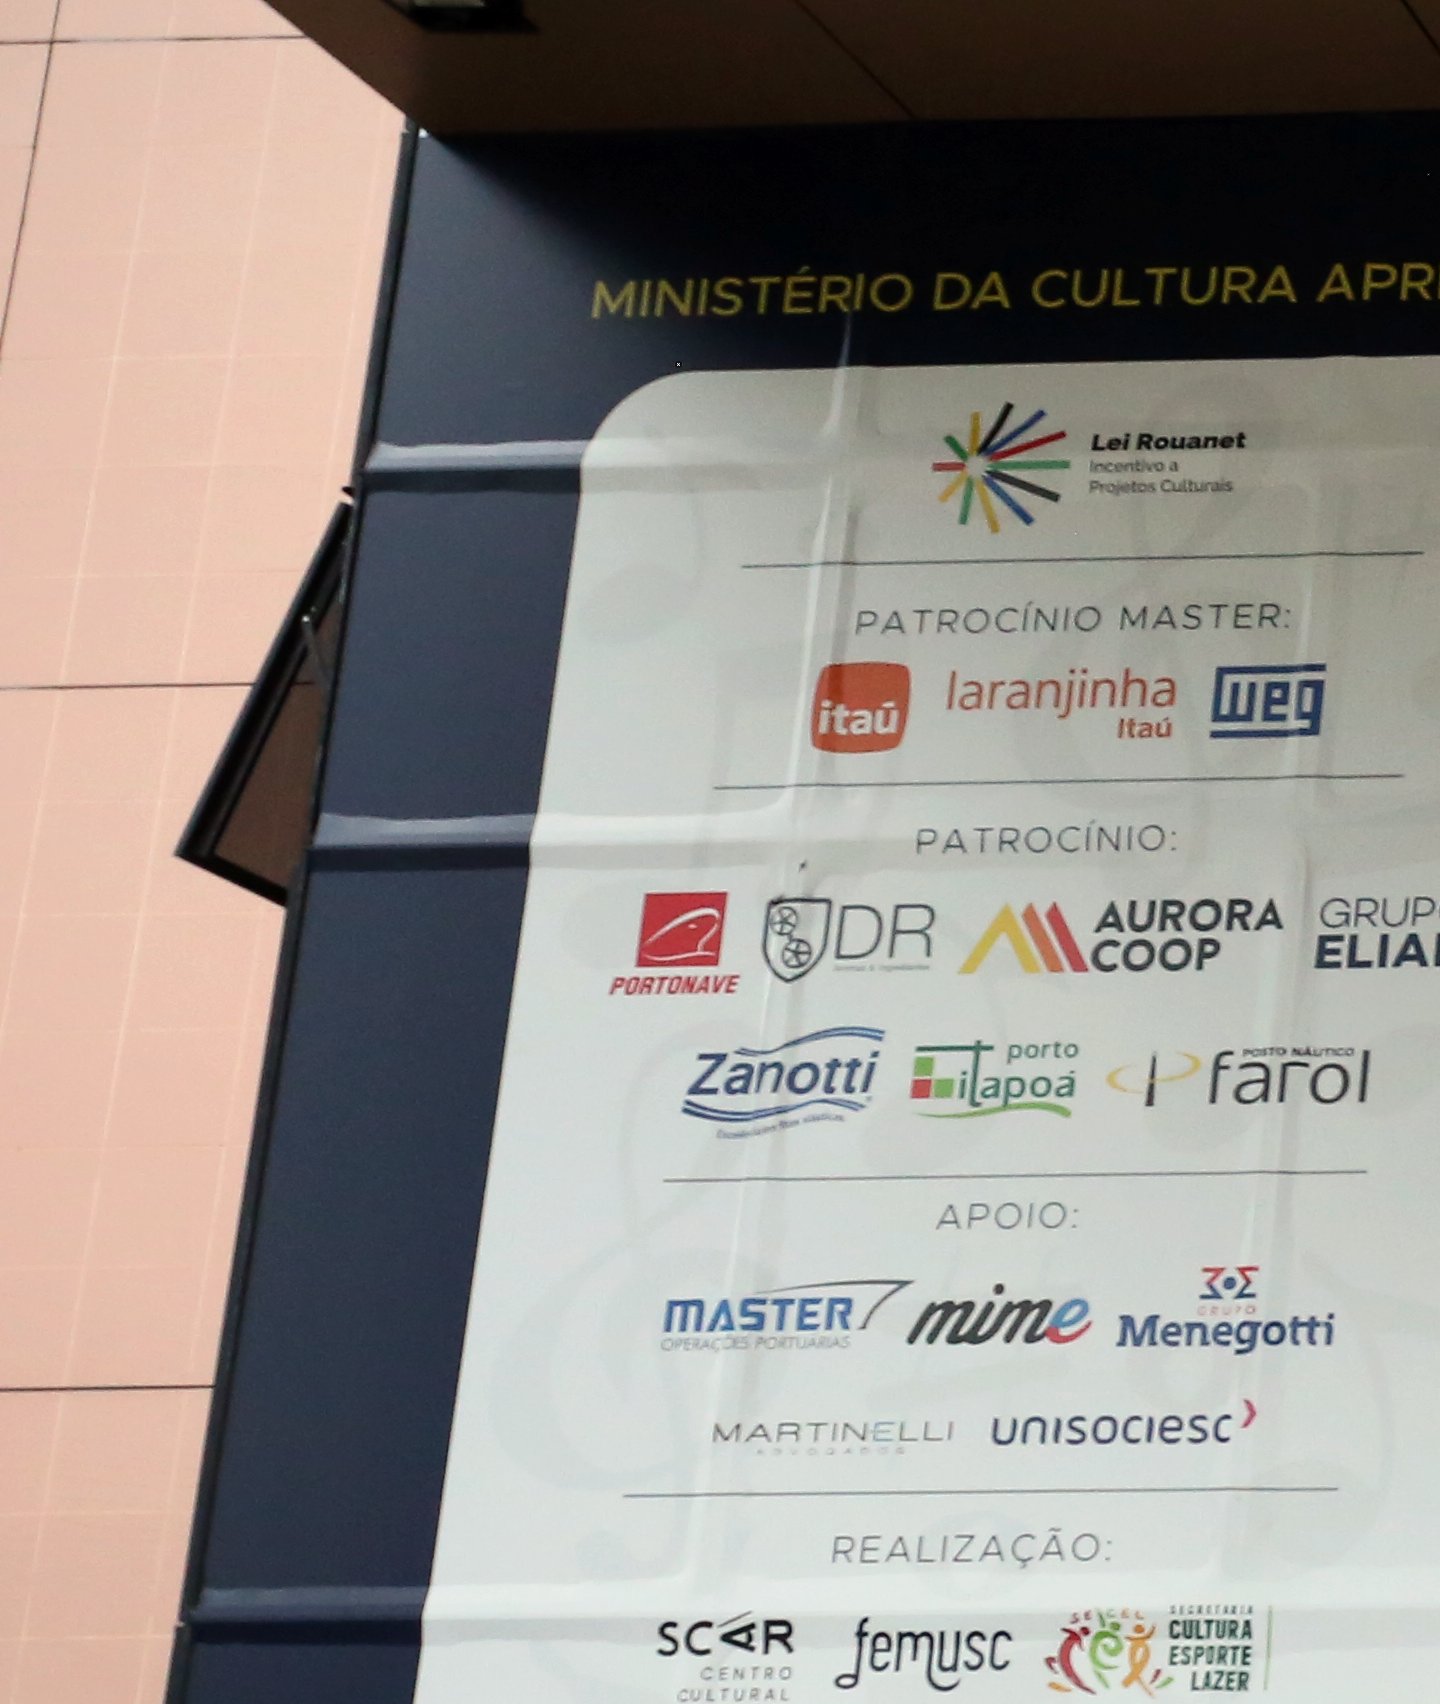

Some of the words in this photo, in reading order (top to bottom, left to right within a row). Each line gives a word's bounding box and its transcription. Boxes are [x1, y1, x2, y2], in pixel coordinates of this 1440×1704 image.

[591, 266, 914, 319] MINISTÉRIO
[932, 271, 1012, 311] DA
[1031, 265, 1297, 308] CULTURA
[1091, 432, 1130, 453] Lei
[1137, 431, 1247, 452] Rouanet
[1089, 460, 1166, 474] Incentivo
[1169, 463, 1179, 473] a
[1089, 480, 1157, 496] Projetos
[1160, 477, 1234, 494] Culturais
[855, 602, 1102, 635] PATROCÍNIO
[1120, 602, 1291, 630] MASTER:
[946, 670, 1177, 718] laranjinha
[818, 702, 900, 736] itaú
[1117, 718, 1172, 740] Itaú
[916, 820, 1177, 854] PATROCÍNIO:
[1094, 900, 1284, 933] AURORA
[1091, 938, 1221, 972] COOP
[609, 975, 740, 996] PORTONAVE
[1007, 1040, 1080, 1065] porto
[687, 1051, 880, 1096] Zanotti
[1209, 1049, 1371, 1105] farol
[936, 1201, 1079, 1231] APOIO:
[662, 1297, 855, 1333] MASTER
[907, 1284, 1092, 1346] mime
[1116, 1313, 1335, 1355] Menegotti
[712, 1420, 955, 1443] MARTINELLI
[991, 1413, 1233, 1446] unisociesc
[832, 1531, 1113, 1570] REALIZAÇÃO:
[1168, 1619, 1253, 1640] CULTURA
[834, 1616, 1013, 1693] femusc
[1168, 1646, 1253, 1666] ESPORTE
[700, 1666, 793, 1681] CENTRO
[1190, 1670, 1250, 1692] LAZER
[676, 1687, 791, 1703] CULTURAL
